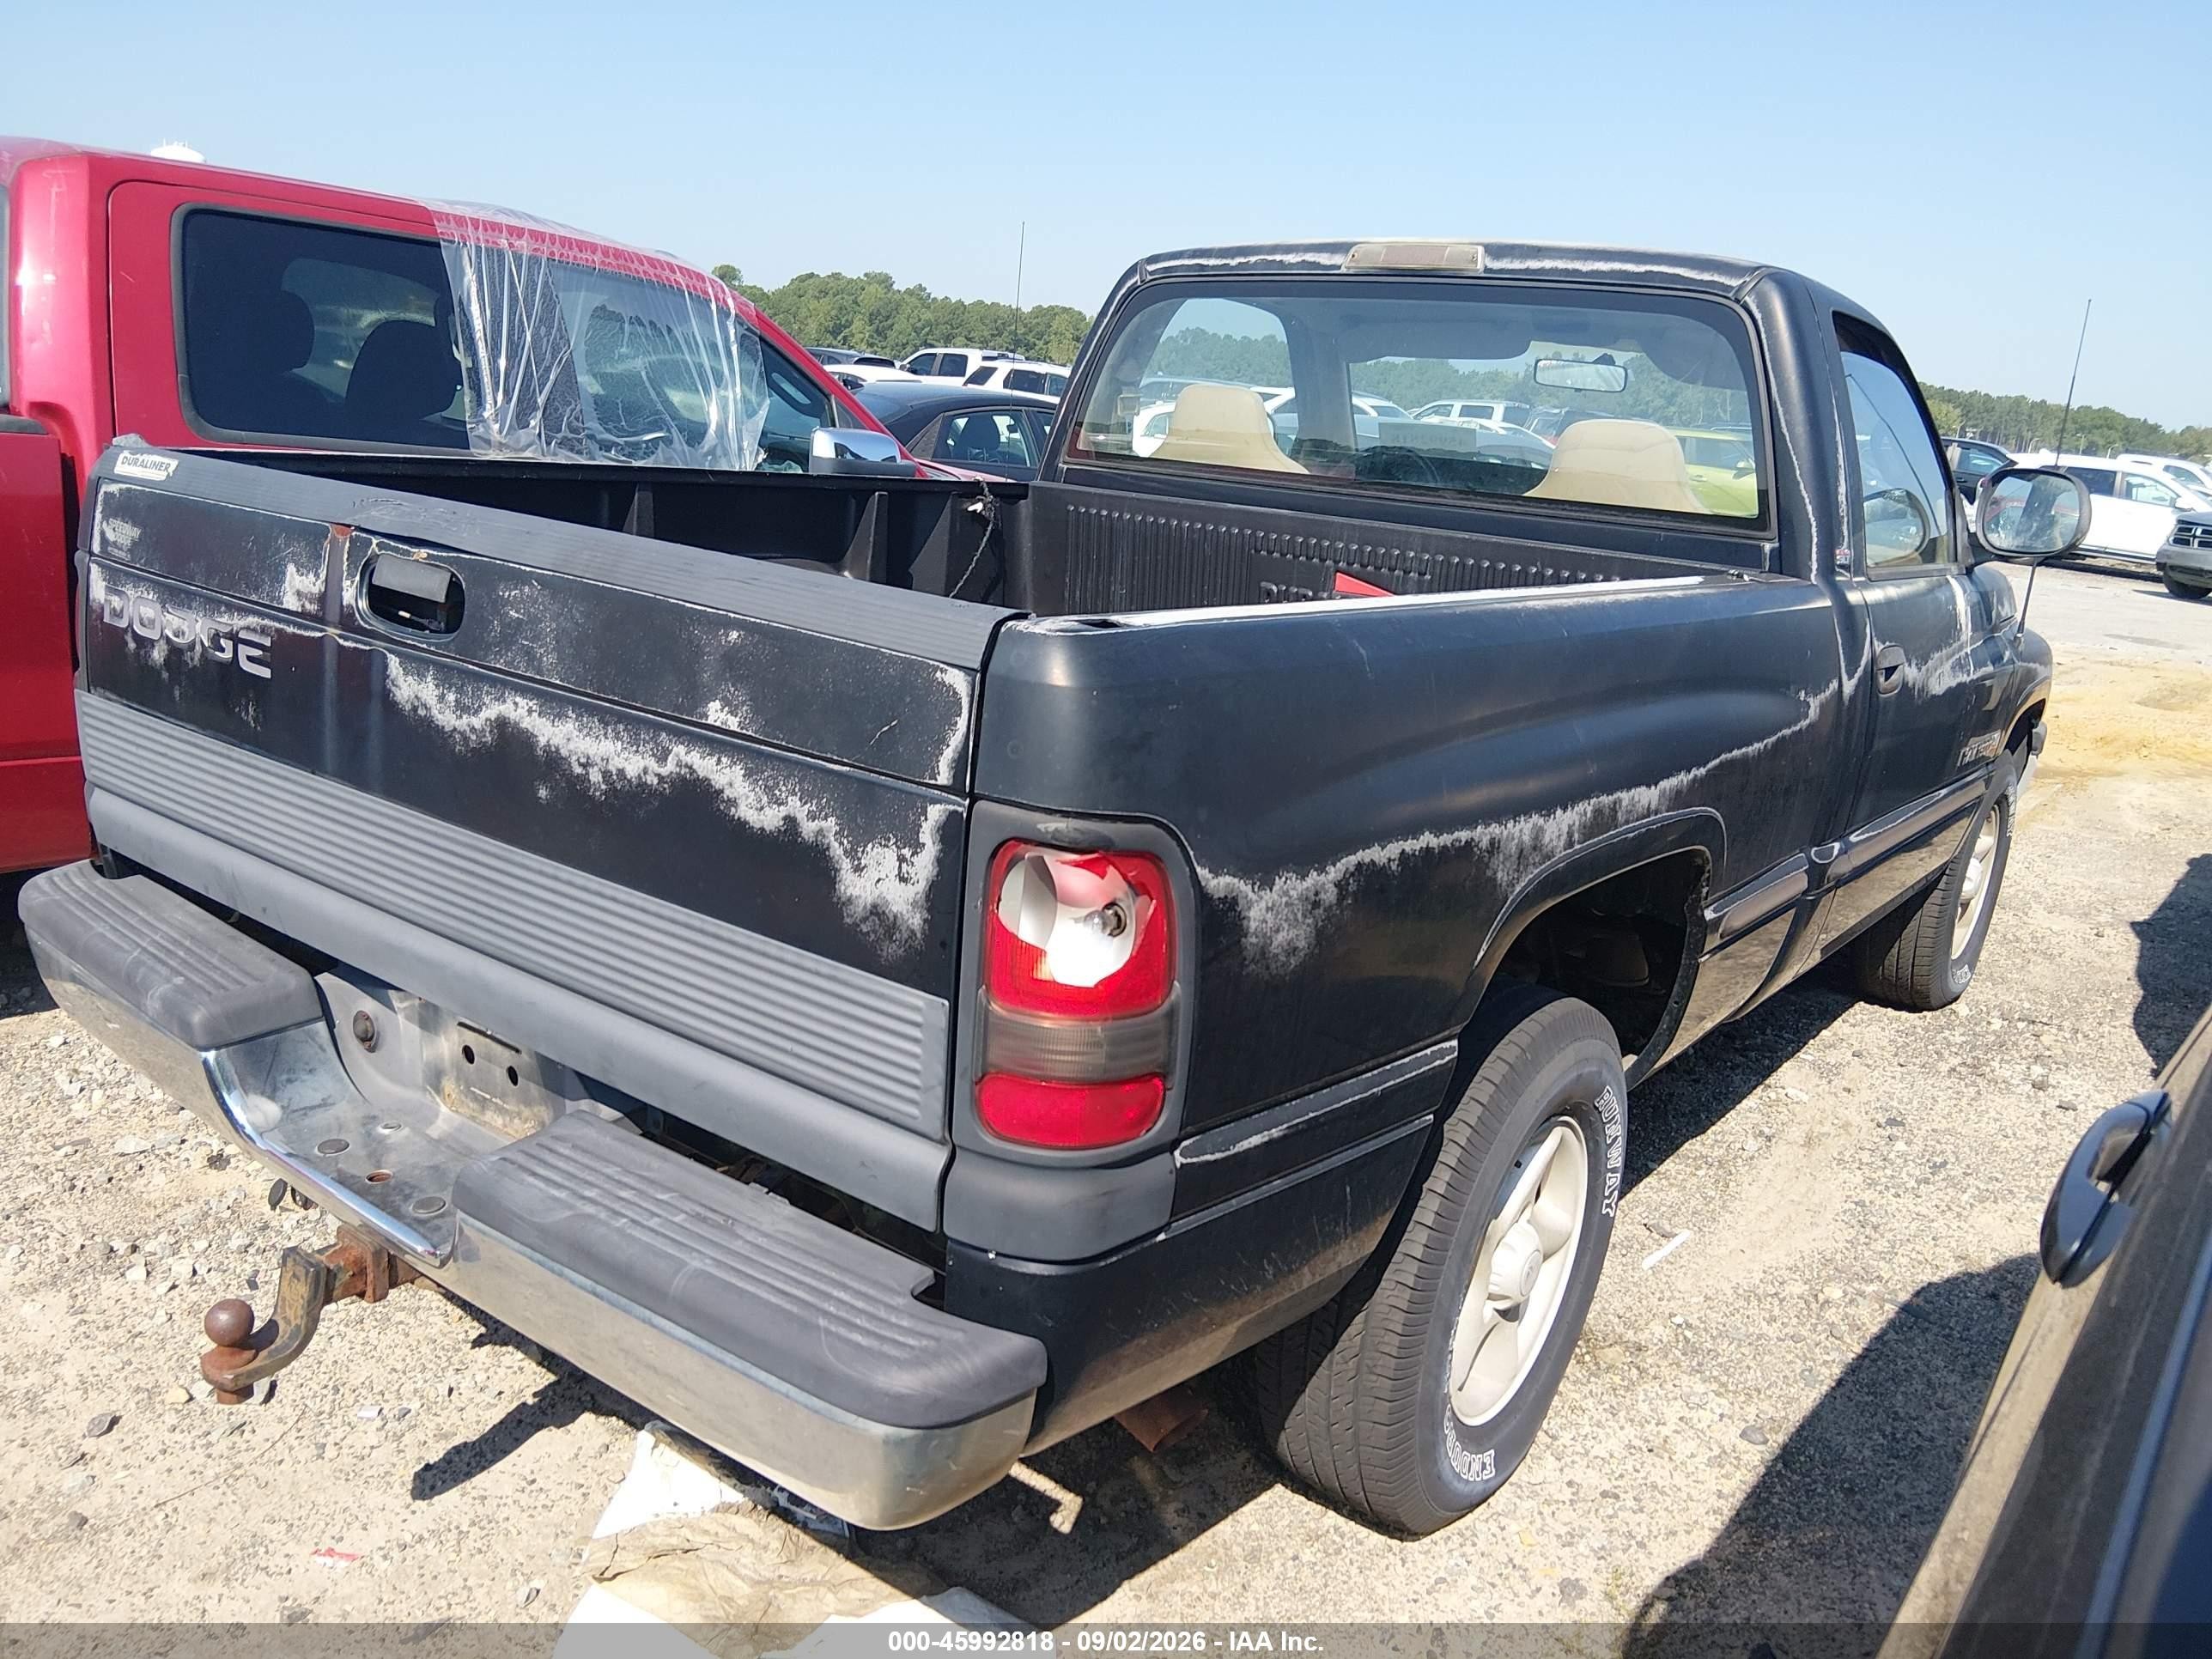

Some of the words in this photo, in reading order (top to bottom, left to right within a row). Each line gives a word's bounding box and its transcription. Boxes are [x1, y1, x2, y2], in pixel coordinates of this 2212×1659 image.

[121, 455, 172, 473] DURALINER
[103, 583, 272, 679] DODGE
[1594, 1085, 1622, 1218] RUNWAY
